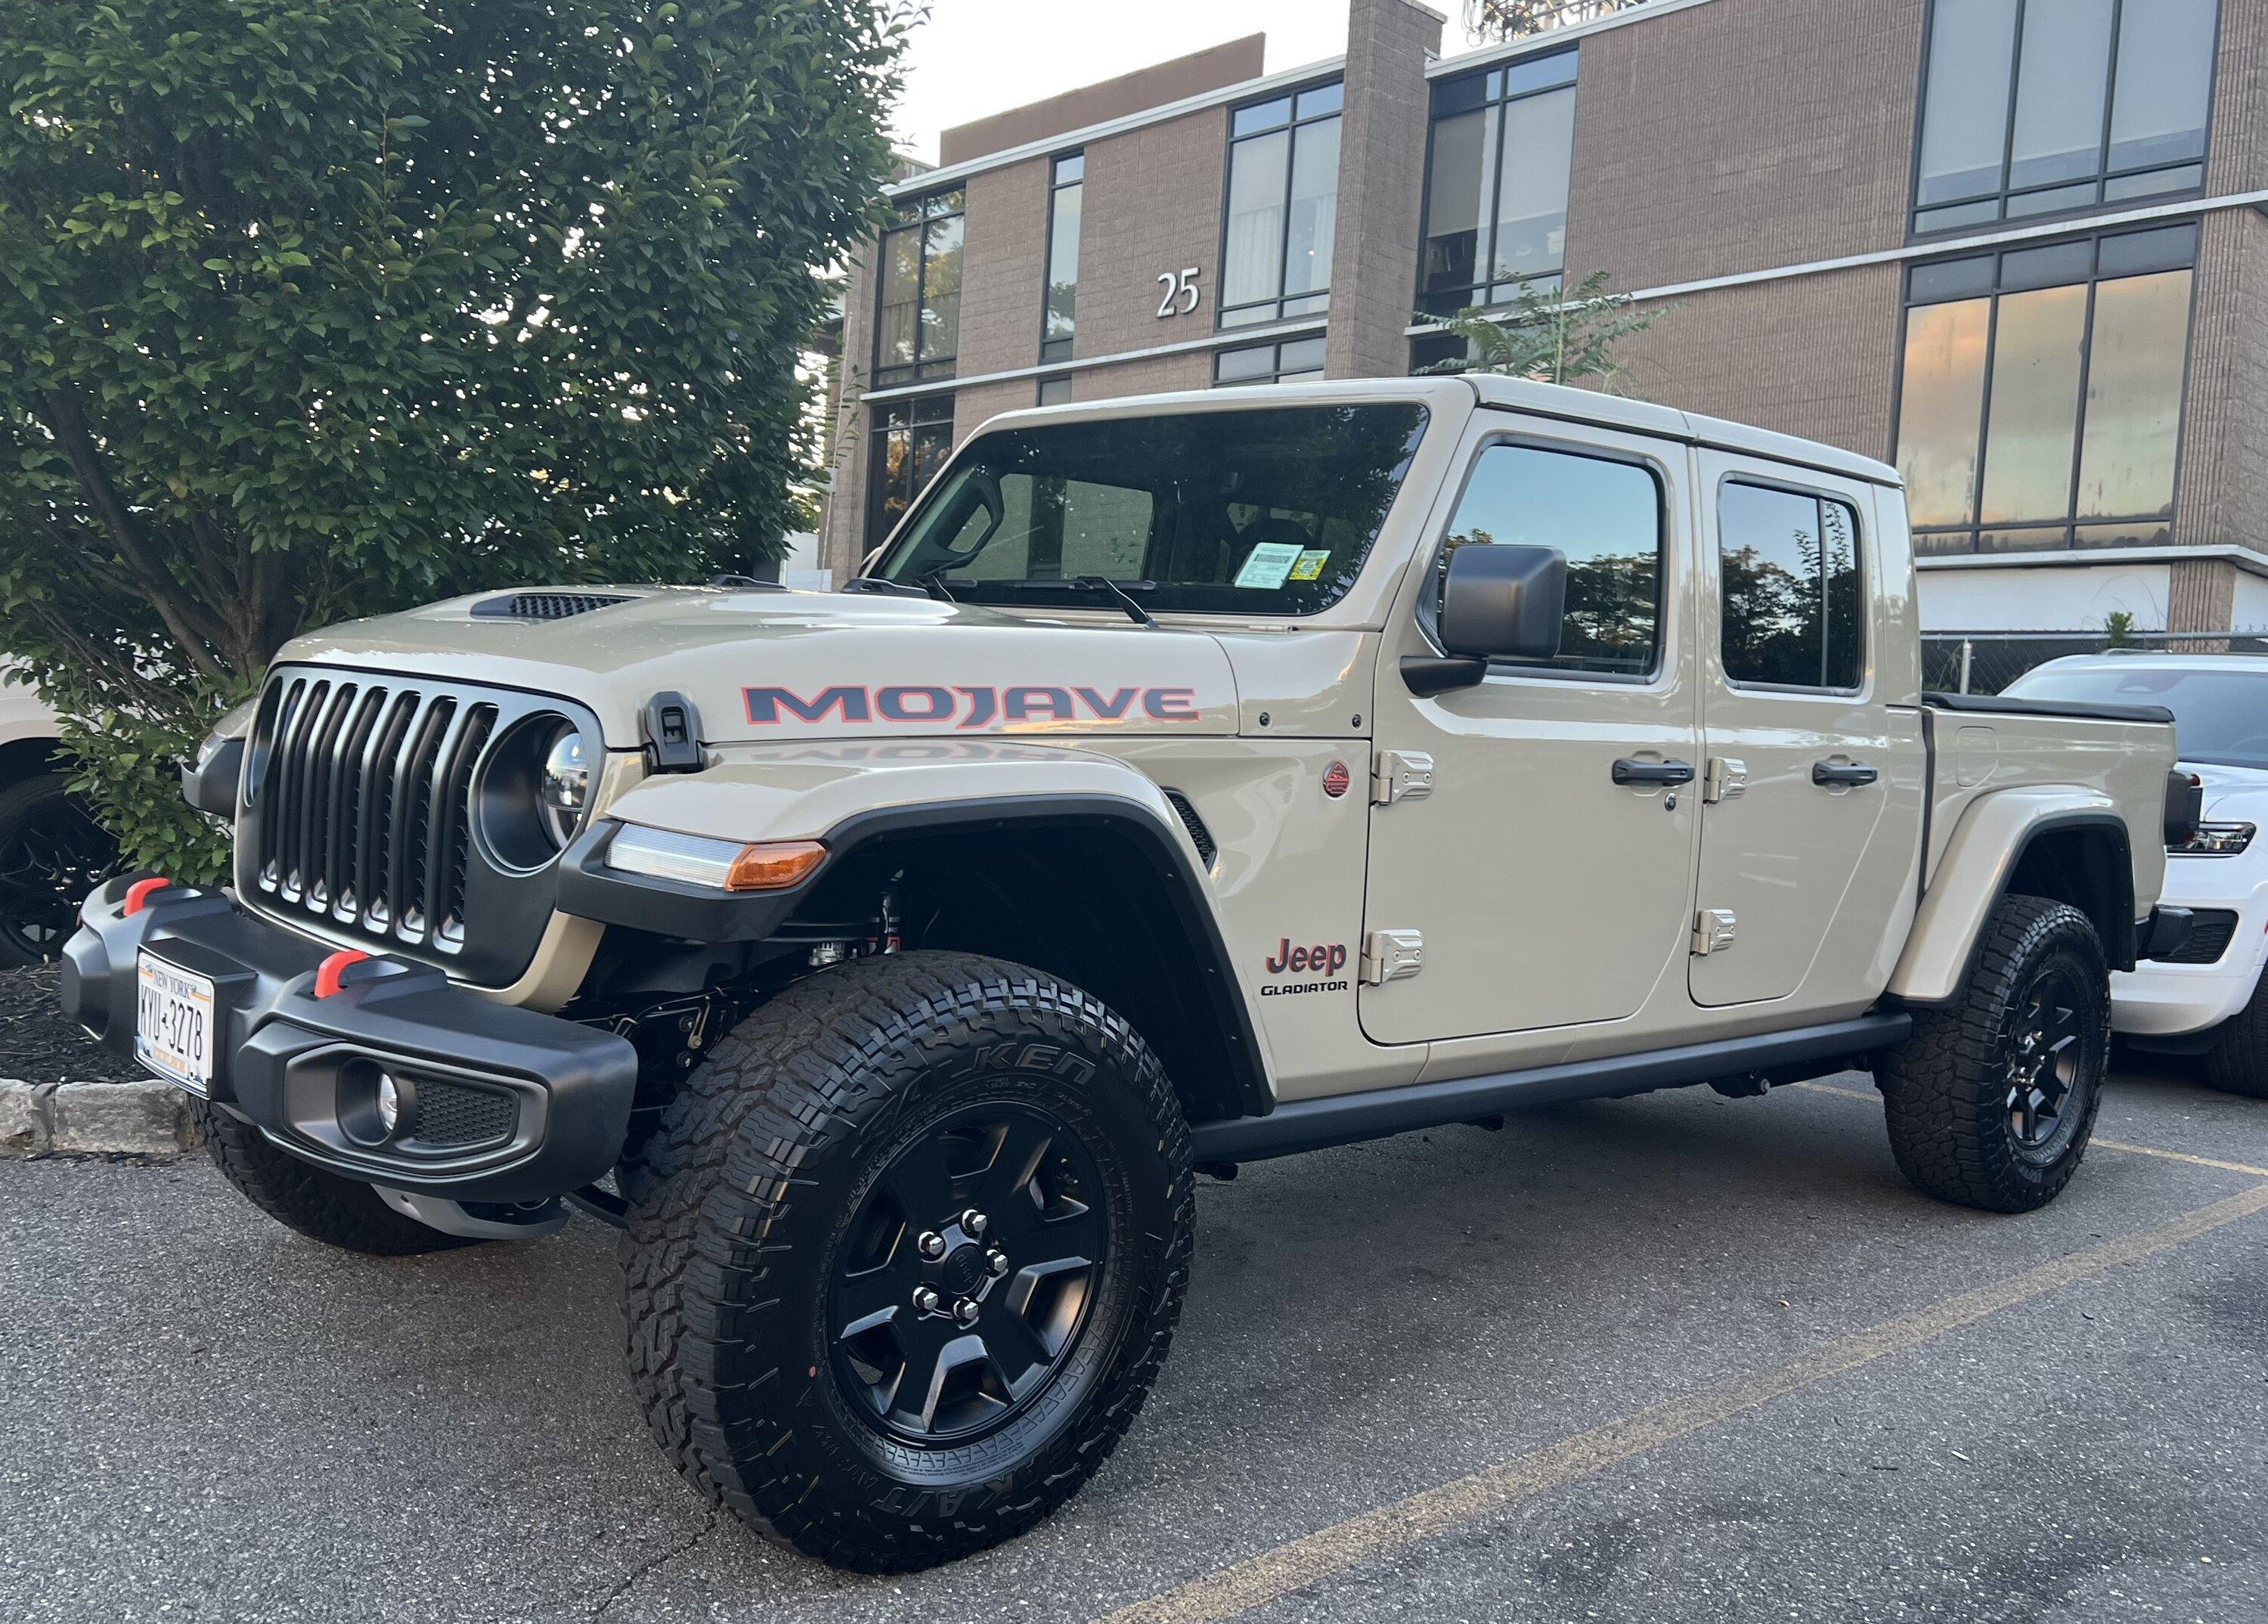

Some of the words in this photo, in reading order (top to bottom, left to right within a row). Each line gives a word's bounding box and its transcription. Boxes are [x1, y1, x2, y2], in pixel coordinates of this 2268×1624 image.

[1156, 267, 1201, 318] 25
[741, 685, 1201, 729] MOJAVE
[1266, 938, 1346, 977] Jeep
[153, 969, 169, 990] NEW
[169, 976, 191, 1000] YORK
[1261, 981, 1348, 996] GLADIATOR
